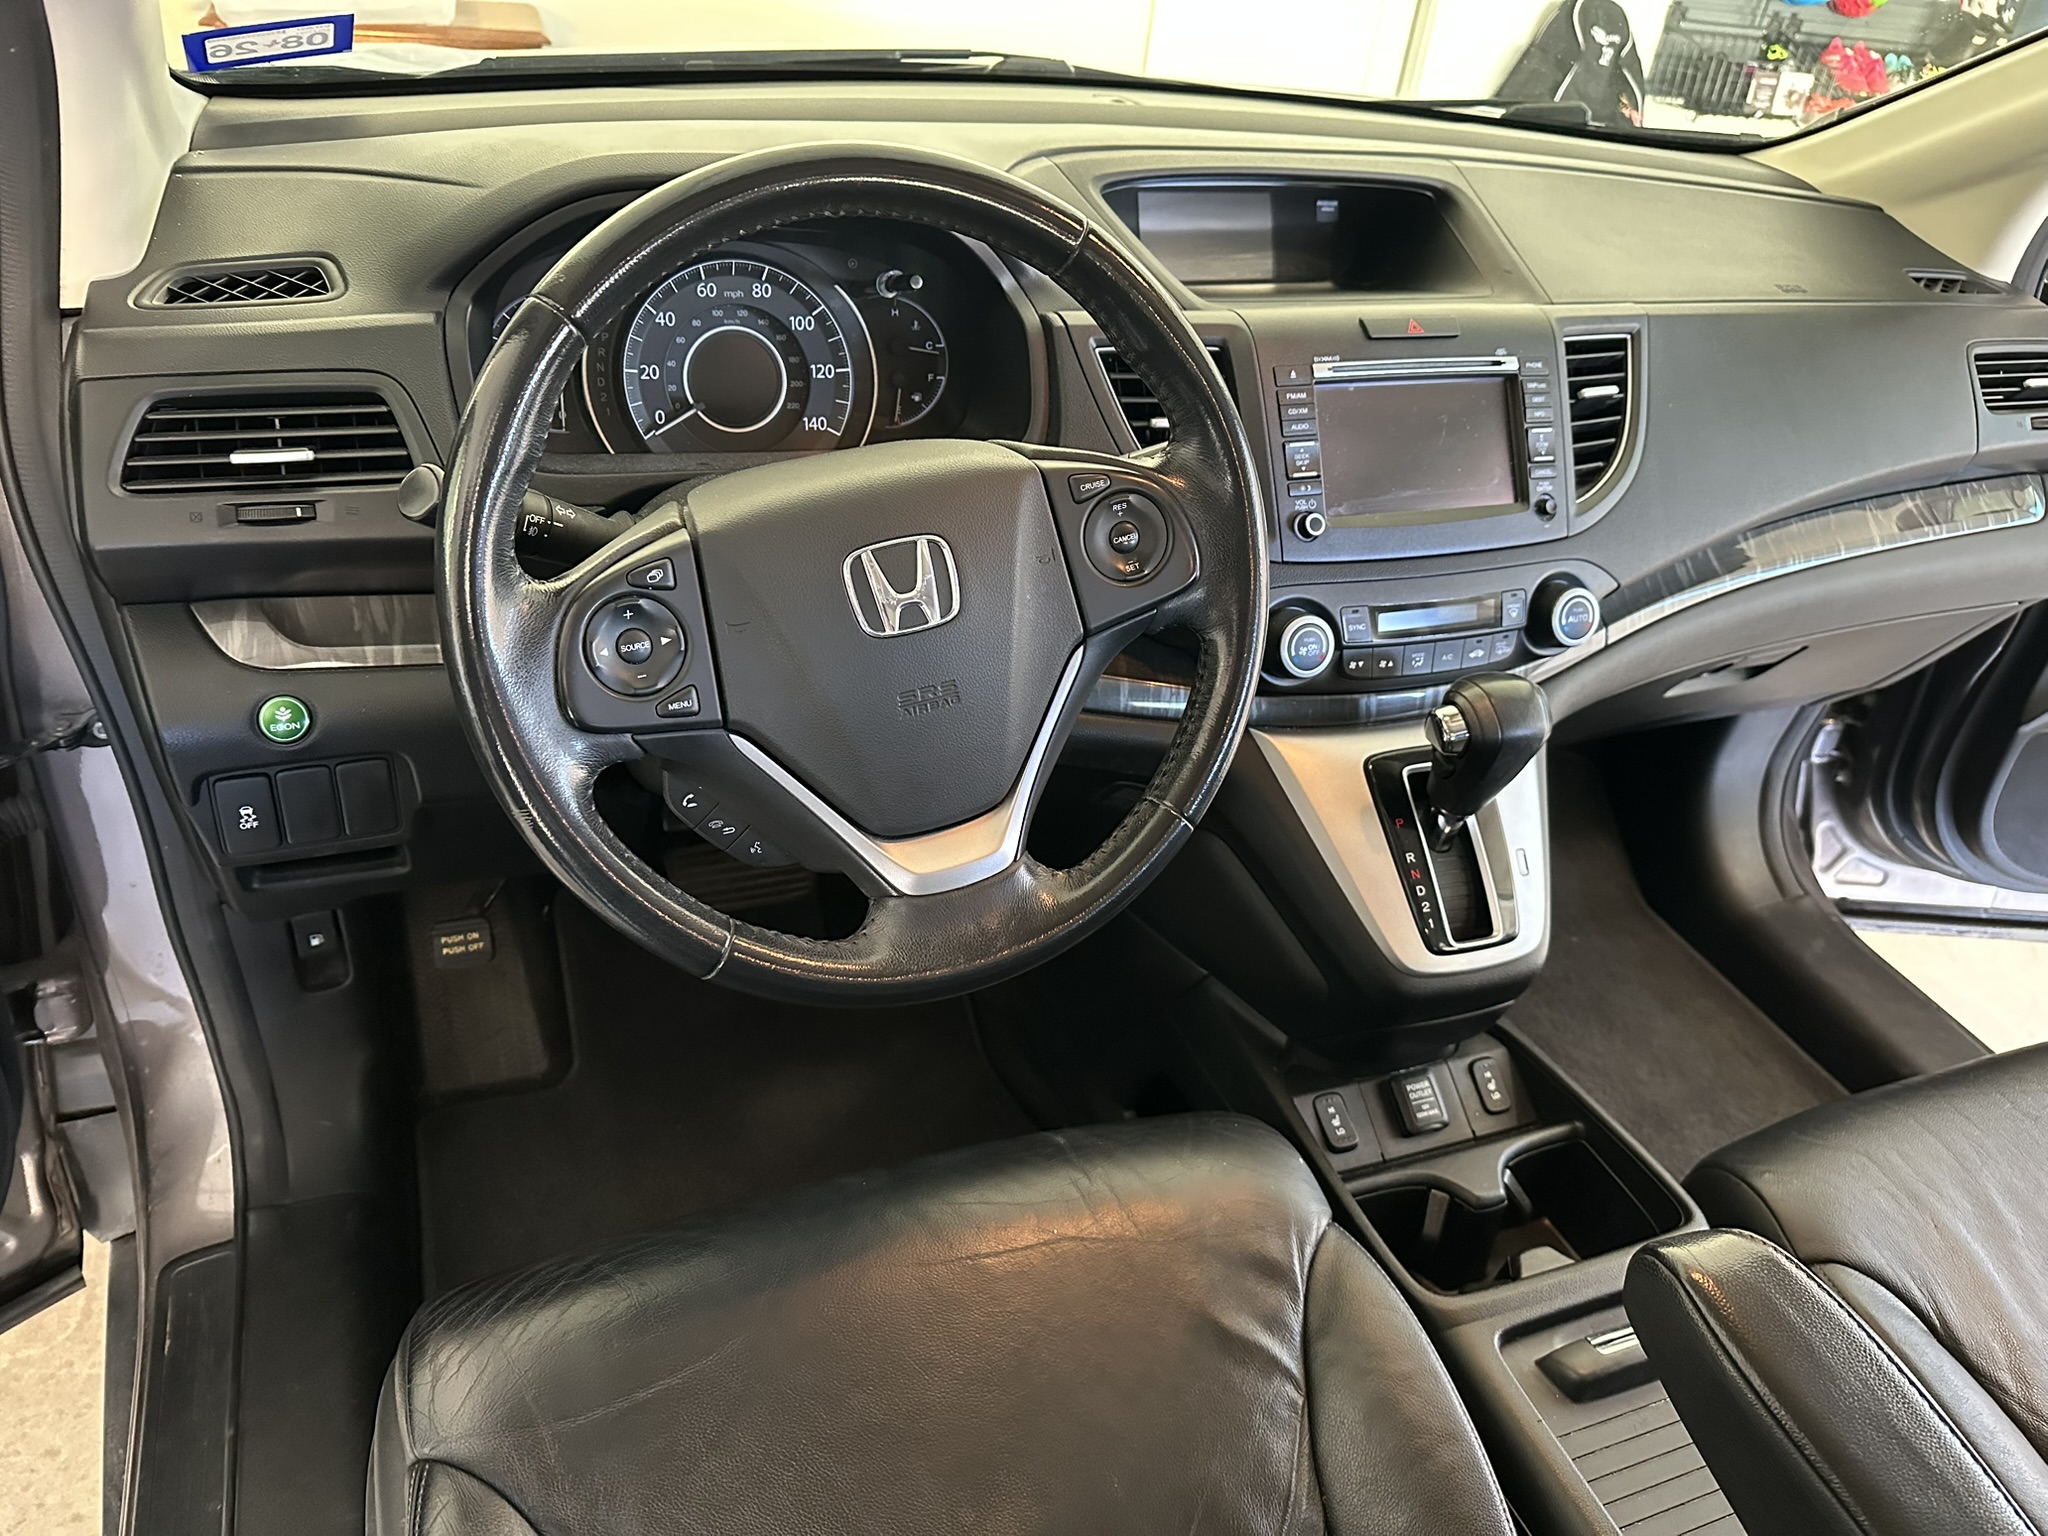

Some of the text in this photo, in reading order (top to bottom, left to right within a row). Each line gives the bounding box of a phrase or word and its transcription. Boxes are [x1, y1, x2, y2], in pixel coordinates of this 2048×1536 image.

[697, 283, 771, 299] 60 mph 80
[712, 309, 723, 317] 100
[737, 309, 748, 317] 120
[891, 309, 899, 317] H
[655, 312, 676, 327] 40
[789, 316, 815, 331] 100
[602, 332, 609, 342] P
[925, 341, 933, 350] C
[640, 364, 660, 380] 20
[811, 365, 834, 379] 120
[928, 374, 935, 382] F
[655, 410, 665, 424] 0
[803, 416, 827, 430] 140
[1080, 480, 1106, 491] CRUISE
[1112, 502, 1128, 512] RES
[529, 514, 546, 524] OFF
[1113, 533, 1138, 544] CANCEL
[1125, 562, 1140, 572] SET
[1568, 614, 1588, 623] AUTO
[1348, 623, 1367, 632] SYNC
[620, 640, 650, 653] SOURCE
[897, 679, 959, 704] SRS
[668, 700, 692, 711] MENU
[269, 722, 301, 732] ECON
[239, 821, 259, 830] OFF
[1395, 818, 1435, 929] P R N D 2 1
[441, 931, 480, 944] PUSH ON
[442, 941, 485, 955] PUSH OFF
[1406, 1080, 1430, 1091] POWER
[1409, 1088, 1432, 1100] OUTLET
